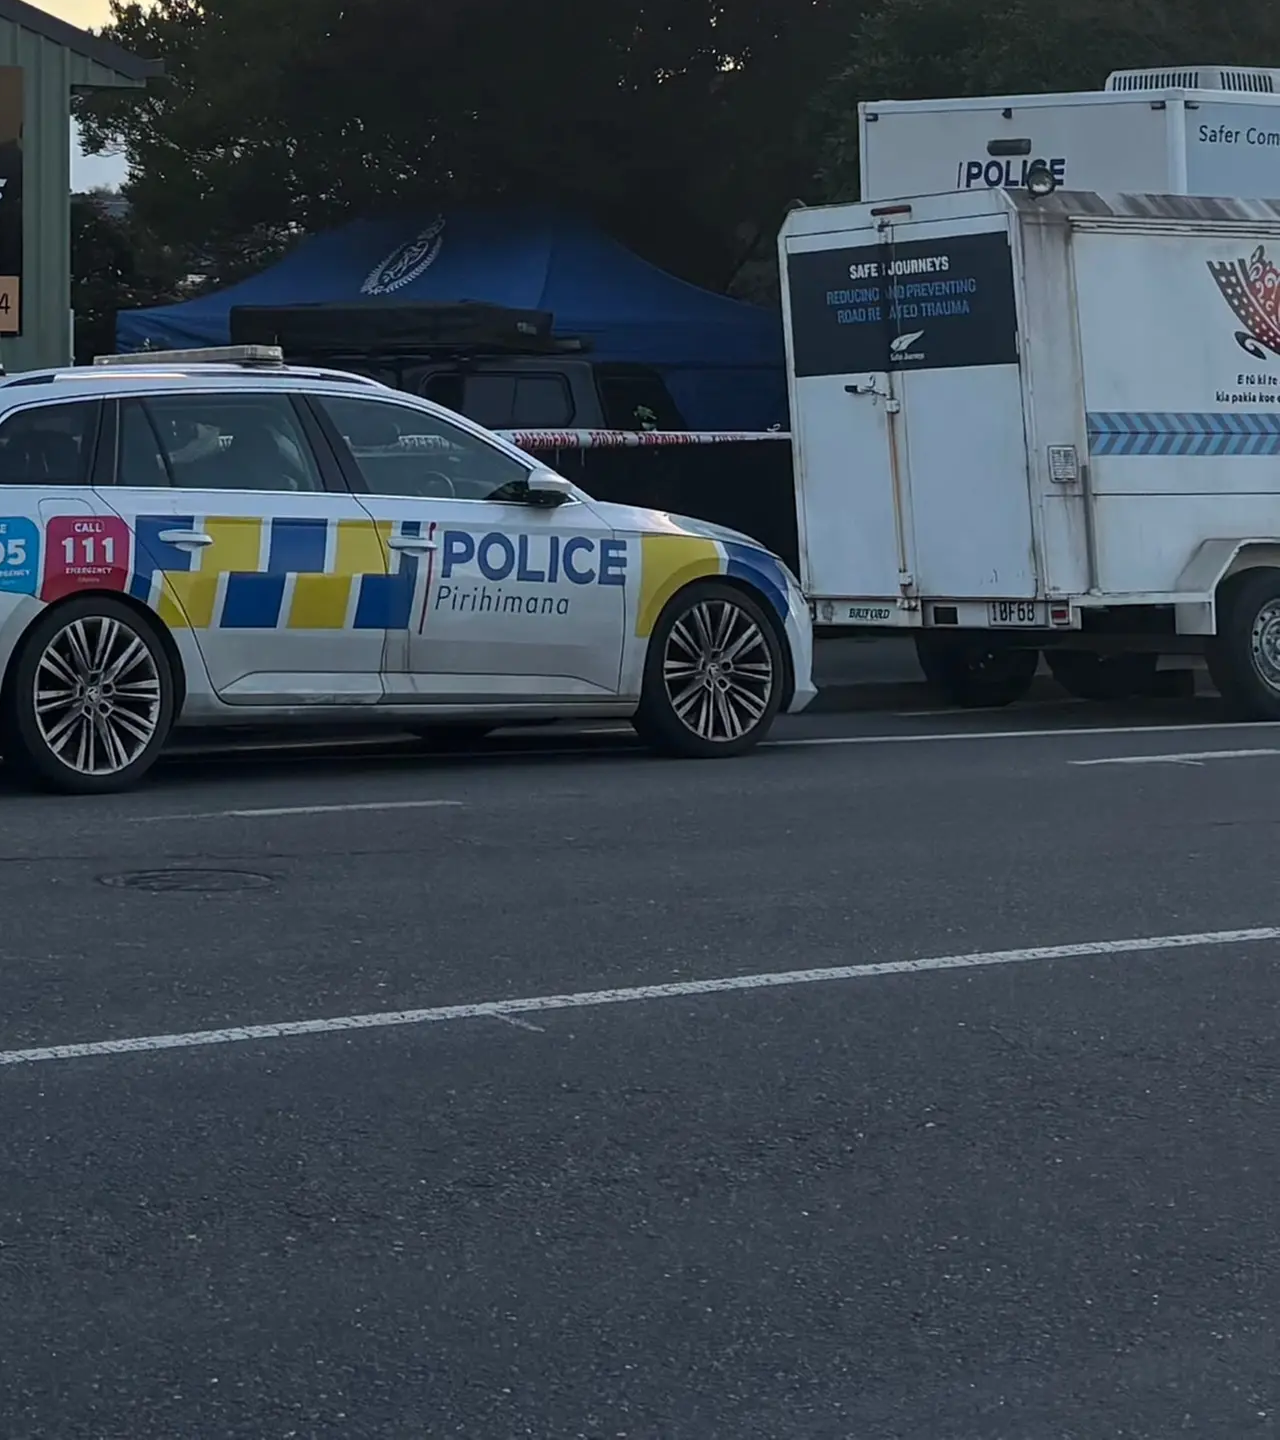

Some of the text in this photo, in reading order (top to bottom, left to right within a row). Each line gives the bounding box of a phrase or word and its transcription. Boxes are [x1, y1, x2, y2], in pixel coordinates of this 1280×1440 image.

[1199, 124, 1240, 143] Safer
[887, 256, 950, 276] JOURNEYS
[826, 287, 880, 306] REDUCING
[906, 278, 977, 299] PREVENTING
[837, 299, 971, 325] ROAD REATED TRAUMA
[1237, 374, 1244, 385] E
[74, 523, 103, 533] CALL
[61, 537, 114, 564] 111
[441, 530, 627, 586] POLICE
[435, 585, 569, 615] Pirihimana
